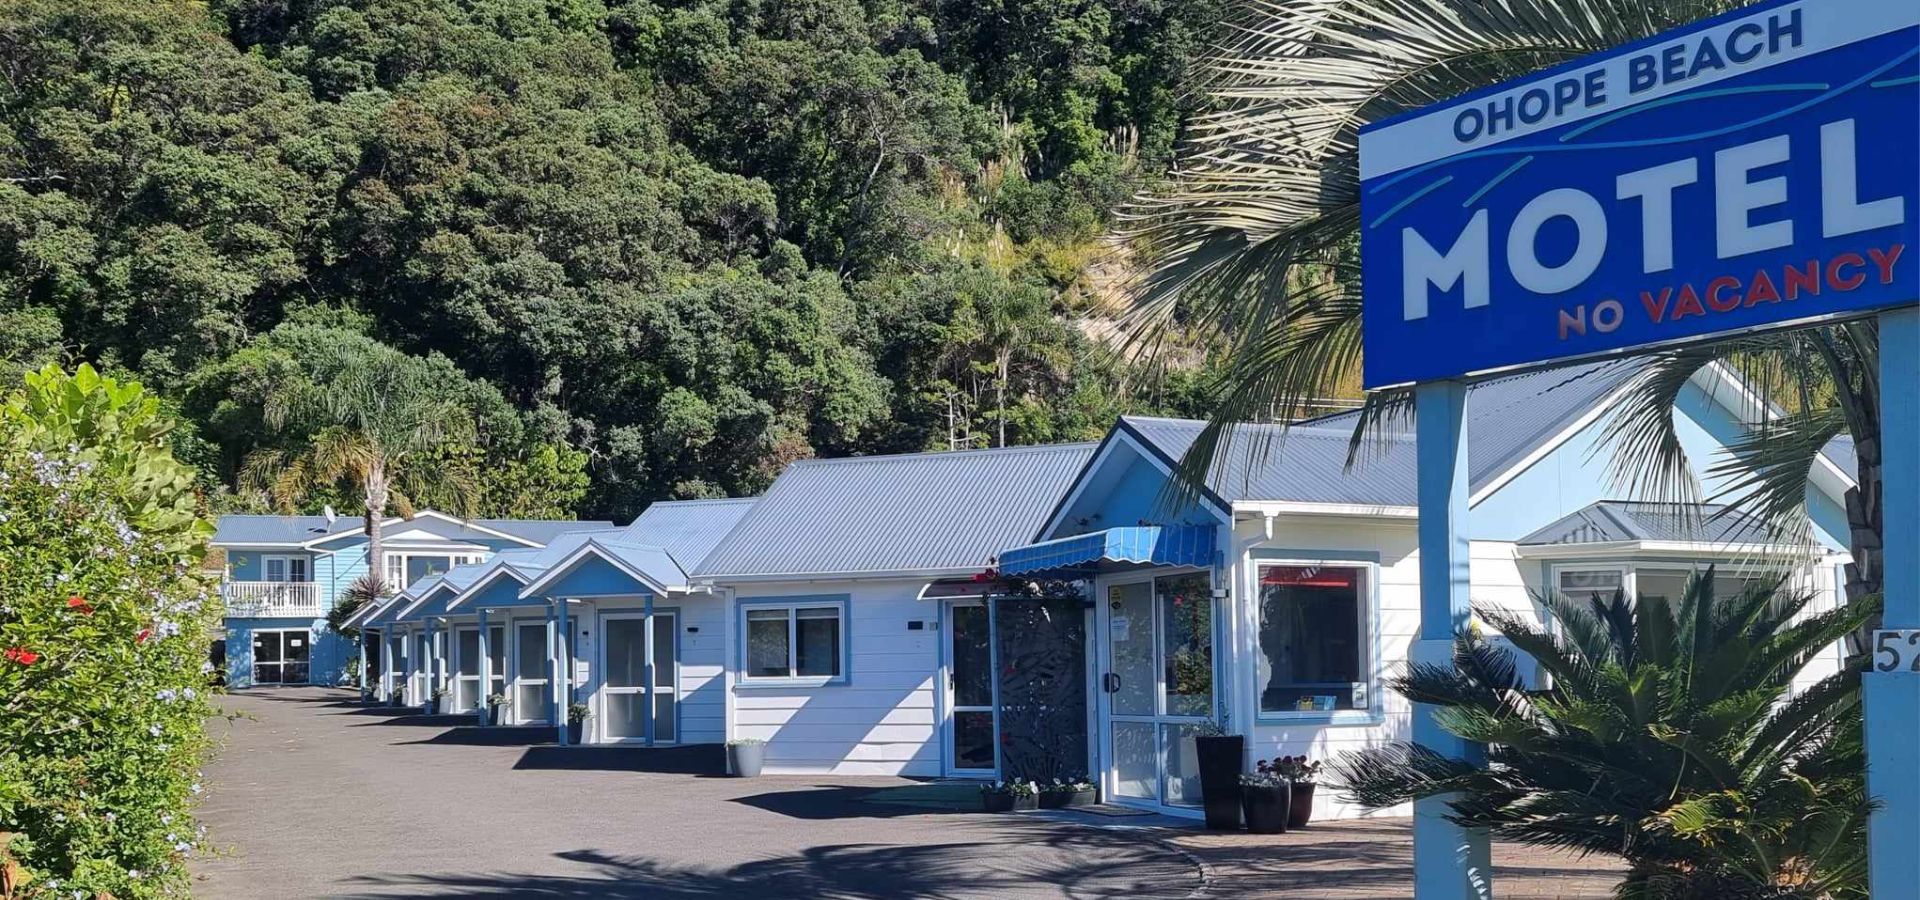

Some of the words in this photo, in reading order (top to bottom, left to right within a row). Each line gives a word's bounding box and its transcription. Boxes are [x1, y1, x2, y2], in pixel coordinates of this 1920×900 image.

[1453, 68, 1606, 143] OHOPE
[1629, 8, 1802, 95] BEACH
[1403, 118, 1904, 321] MOTEL
[1558, 300, 1624, 340] NO
[1640, 243, 1905, 324] VACANCY
